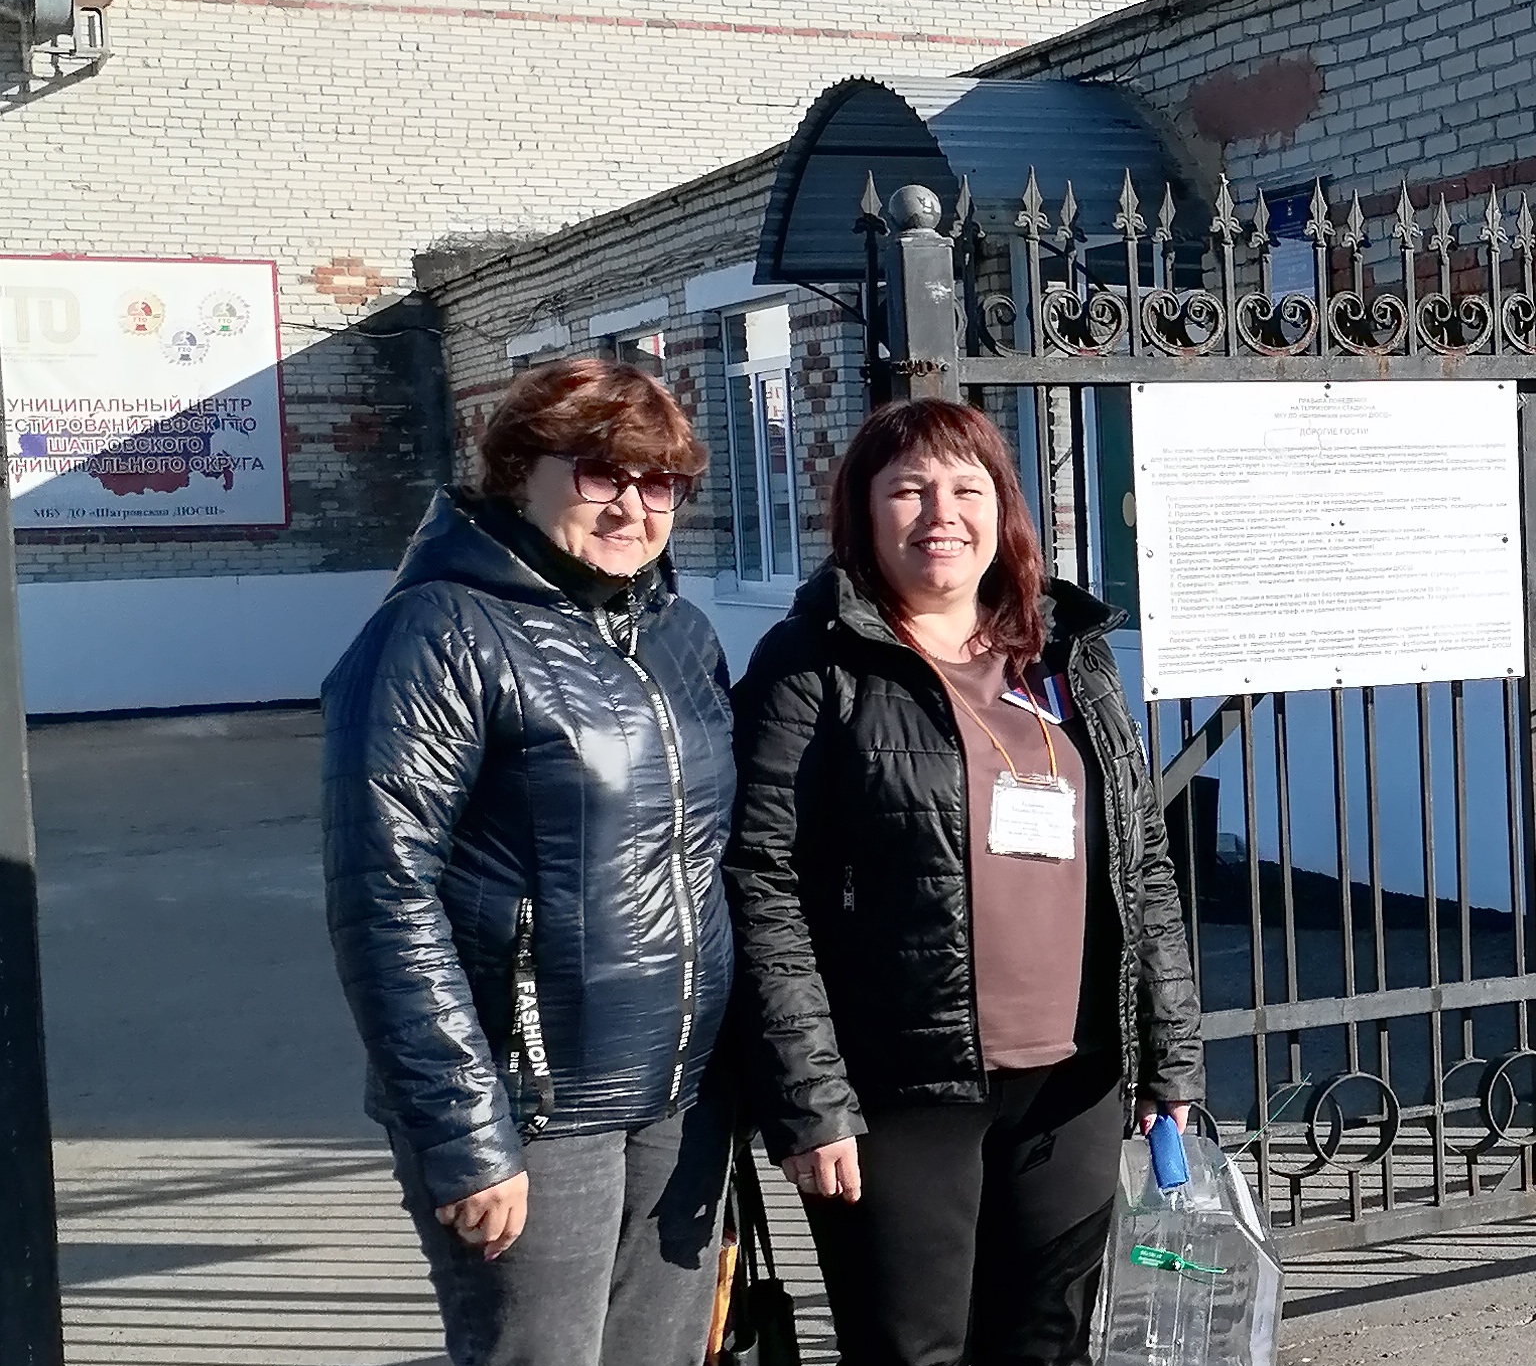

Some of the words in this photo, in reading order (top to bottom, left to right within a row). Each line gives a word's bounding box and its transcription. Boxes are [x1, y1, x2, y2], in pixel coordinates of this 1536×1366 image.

[0, 285, 81, 344] ТО
[6, 394, 181, 415] УНИЦИПАЛЬНЫЙ
[188, 398, 252, 415] ЦЕНТР
[4, 418, 153, 433] ЕСТИРОВАНИЯ
[160, 418, 215, 432] ВФСК
[221, 417, 257, 432] ГТО
[1299, 428, 1338, 436] ДОРОГИЕ
[48, 437, 204, 453] ШАТРОВСКОГО
[8, 457, 186, 474] НИЦИПАЛЬНОГО
[190, 456, 265, 473] ОКРУГА
[673, 798, 683, 838] DIESEL
[671, 853, 685, 893] DIESEL
[680, 907, 694, 947] DIESEL
[683, 961, 694, 1000] DIESEL
[516, 981, 550, 1077] FASHION
[678, 1014, 692, 1051] DIESEL
[669, 1063, 684, 1101] DIESEL
